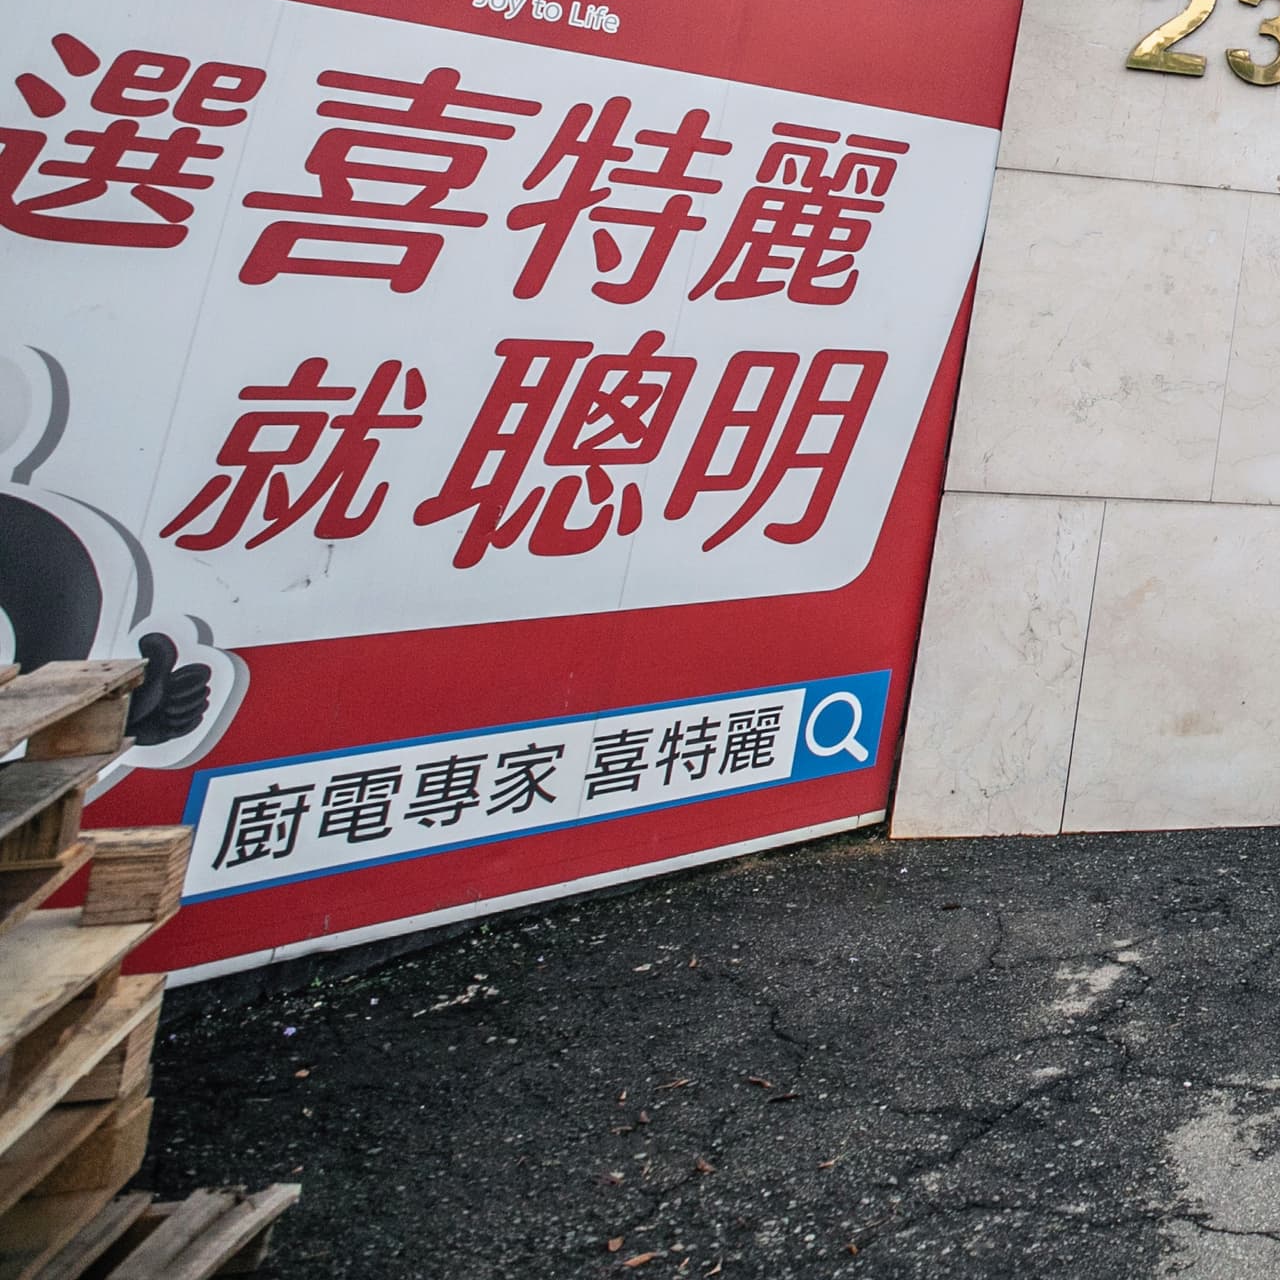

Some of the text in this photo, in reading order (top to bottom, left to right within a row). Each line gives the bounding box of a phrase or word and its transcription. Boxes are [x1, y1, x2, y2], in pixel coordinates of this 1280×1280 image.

[568, 1, 620, 33] Life
[0, 33, 911, 305] 選喜特麗
[159, 329, 889, 570] 就聰明
[211, 705, 785, 872] 廚電專家 喜特麗
